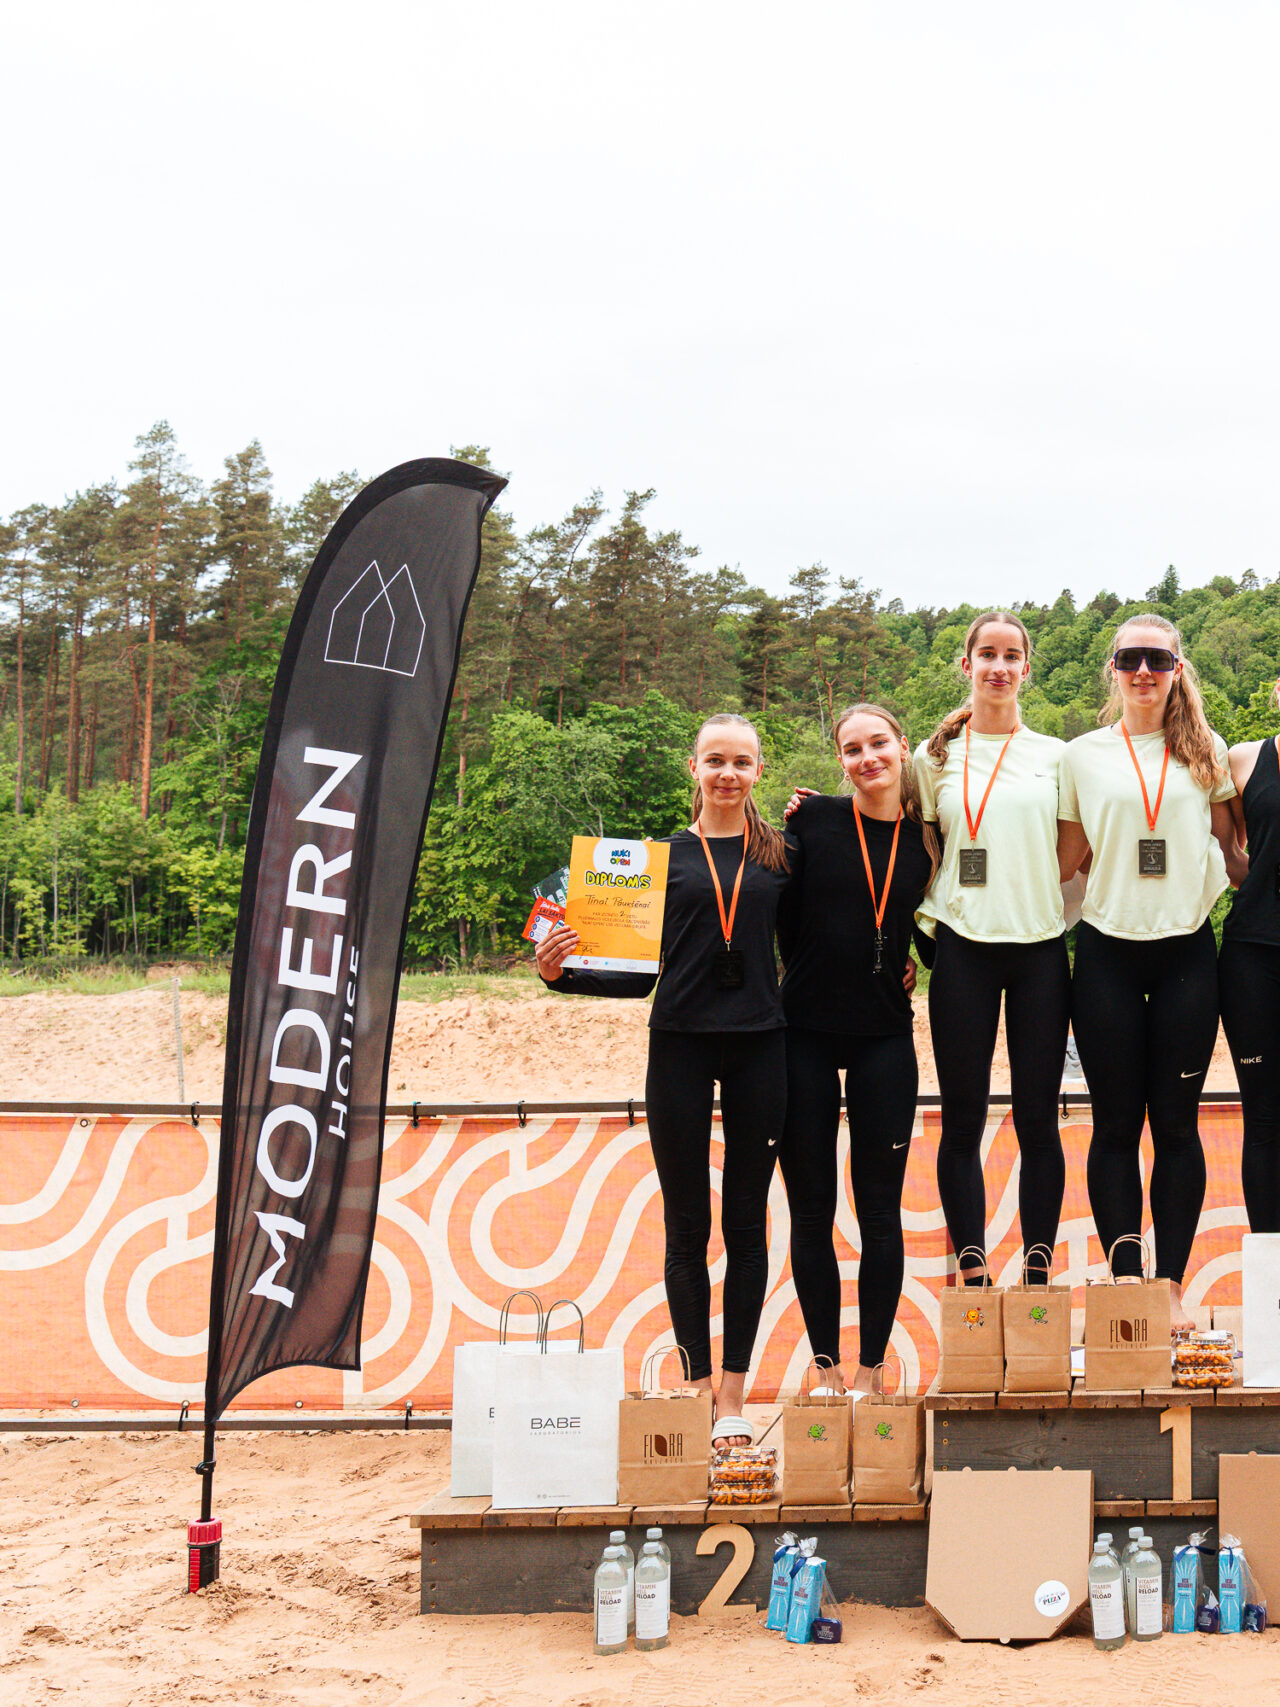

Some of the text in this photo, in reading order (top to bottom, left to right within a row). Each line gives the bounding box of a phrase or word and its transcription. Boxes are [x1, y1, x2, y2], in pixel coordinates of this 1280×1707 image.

[610, 857, 631, 866] OPEN
[611, 849, 631, 858] NUKI
[585, 871, 652, 889] DIPLOMS
[248, 746, 364, 1309] MODERN
[1240, 1055, 1263, 1064] NIKE
[530, 1416, 581, 1430] BABE
[1160, 1405, 1192, 1500] 1
[695, 1522, 757, 1616] 2
